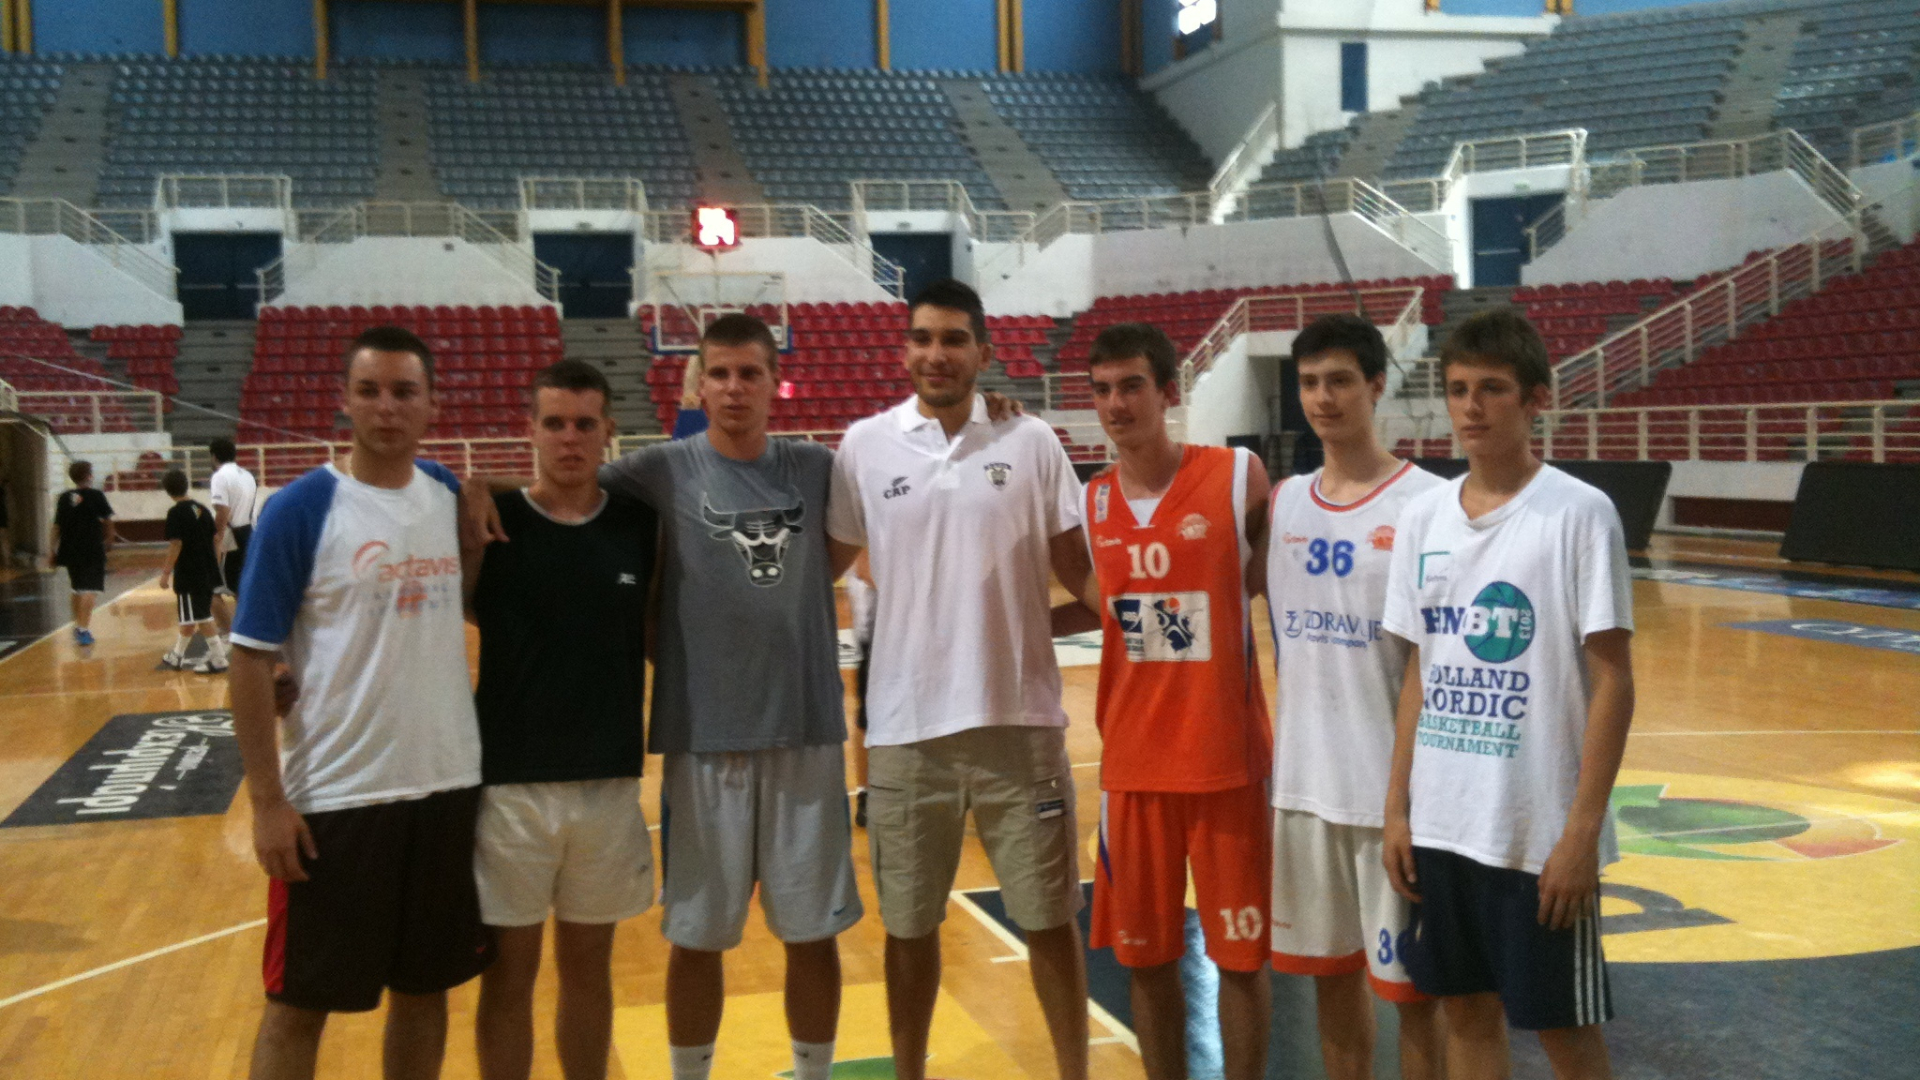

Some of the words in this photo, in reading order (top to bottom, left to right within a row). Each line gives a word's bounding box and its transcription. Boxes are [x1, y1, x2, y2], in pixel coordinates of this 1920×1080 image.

[883, 485, 911, 500] CAP
[1127, 542, 1171, 579] 10
[1306, 537, 1355, 577] 36
[1220, 906, 1263, 940] 10
